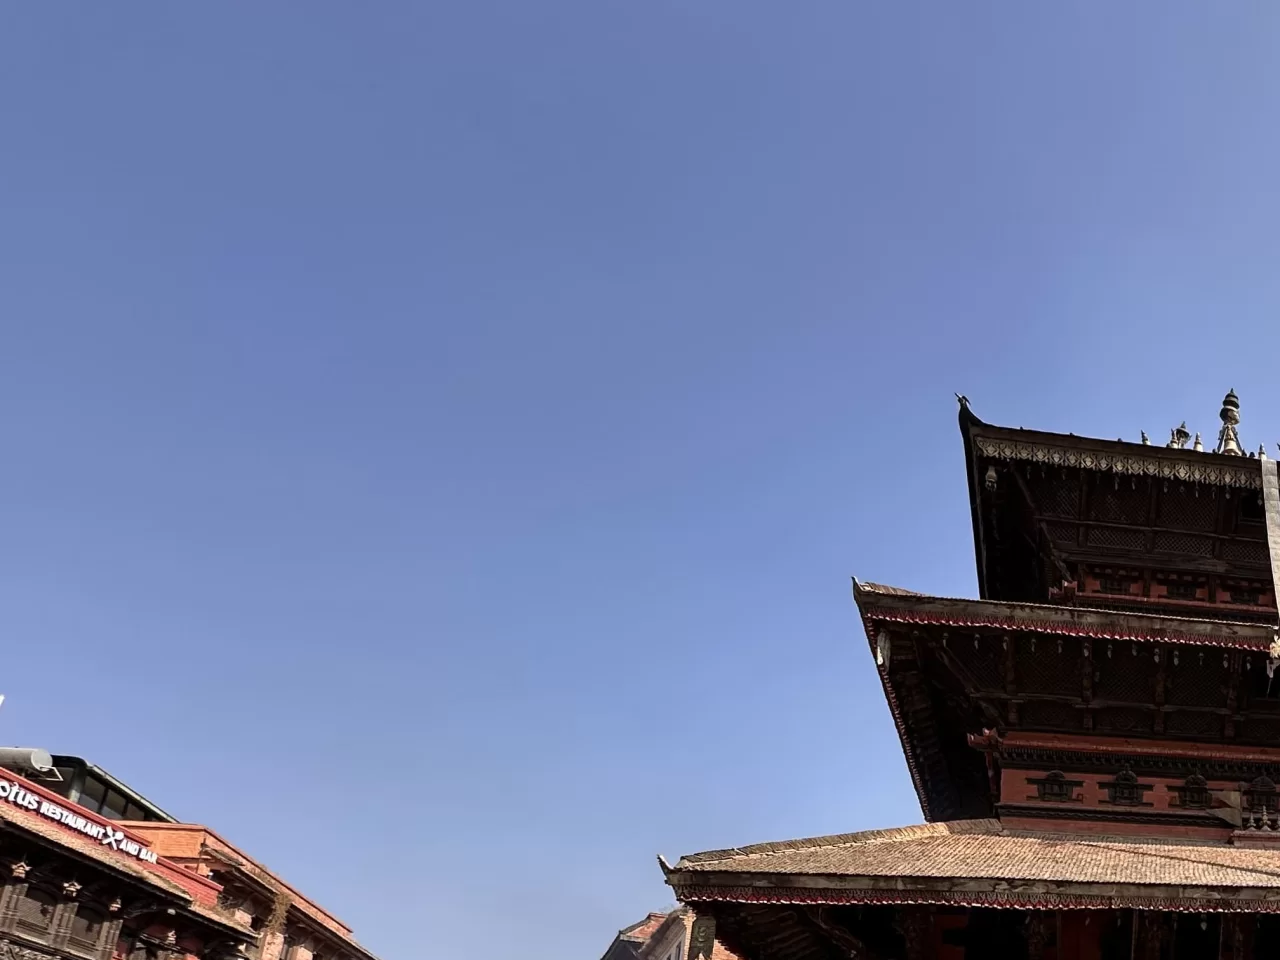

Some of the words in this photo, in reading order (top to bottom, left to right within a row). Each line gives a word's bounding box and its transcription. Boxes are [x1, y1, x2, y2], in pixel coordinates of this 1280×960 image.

[40, 801, 106, 840] RESTAURANT
[118, 839, 140, 856] AND
[139, 846, 158, 864] BAR
